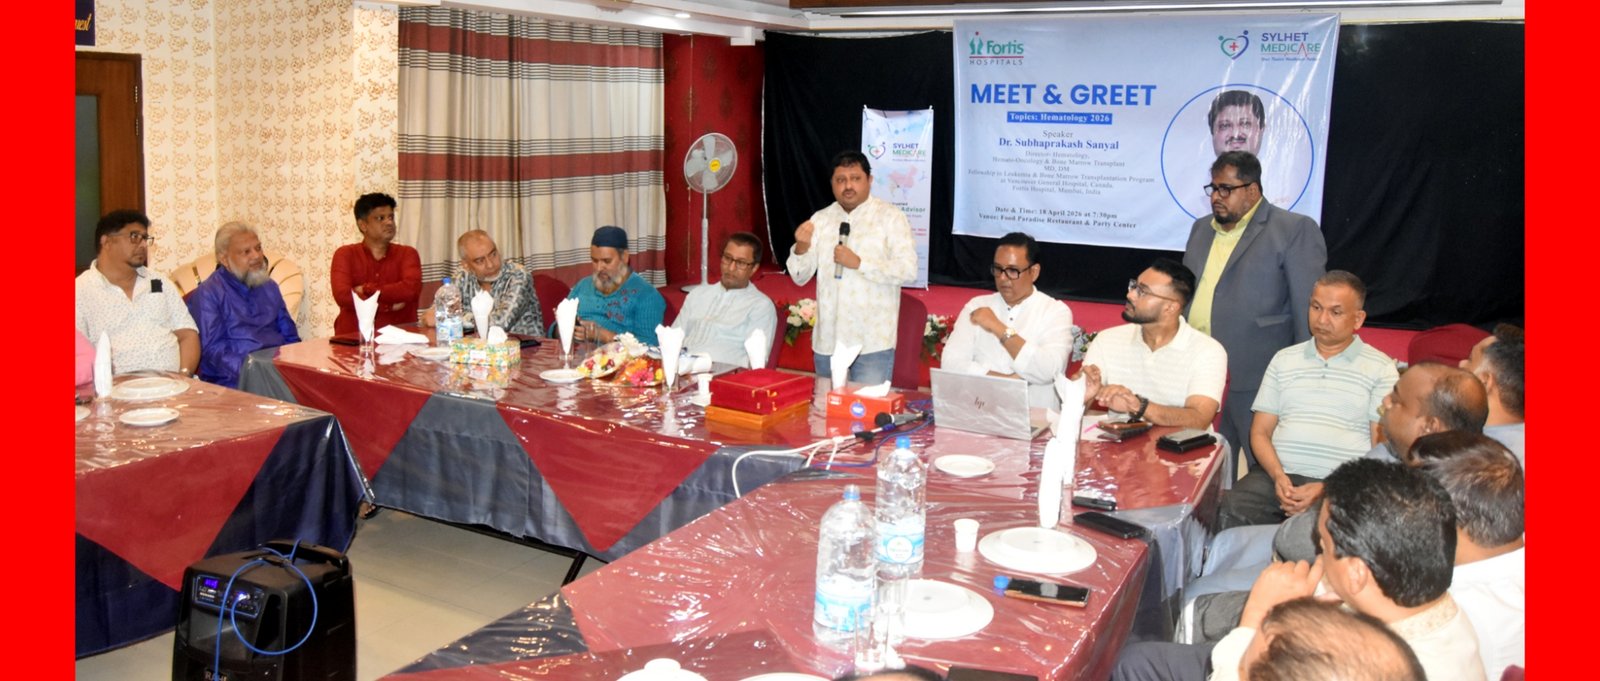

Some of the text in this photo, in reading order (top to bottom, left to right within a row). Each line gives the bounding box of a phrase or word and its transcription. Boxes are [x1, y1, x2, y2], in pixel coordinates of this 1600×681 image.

[1261, 32, 1309, 42] SYLHET
[986, 40, 1025, 55] Fortis
[1260, 42, 1321, 53] MEDICARE
[971, 83, 1157, 106] MEET & GREET
[1009, 112, 1110, 123] Topics: Hematology 2026
[1042, 130, 1074, 139] Speaker
[999, 138, 1119, 151] Dr. Subhaprakash Sanyal
[1056, 172, 1079, 180] Marrow
[1081, 174, 1127, 182] Transplantation
[1128, 175, 1155, 183] Program
[979, 212, 999, 220] Venue:
[1017, 215, 1045, 223] Paradise
[1047, 217, 1082, 225] Restaurant
[1093, 220, 1111, 228] Party
[1113, 220, 1137, 228] Center
[1048, 209, 1065, 217] April
[1092, 211, 1118, 220] 7:30pm
